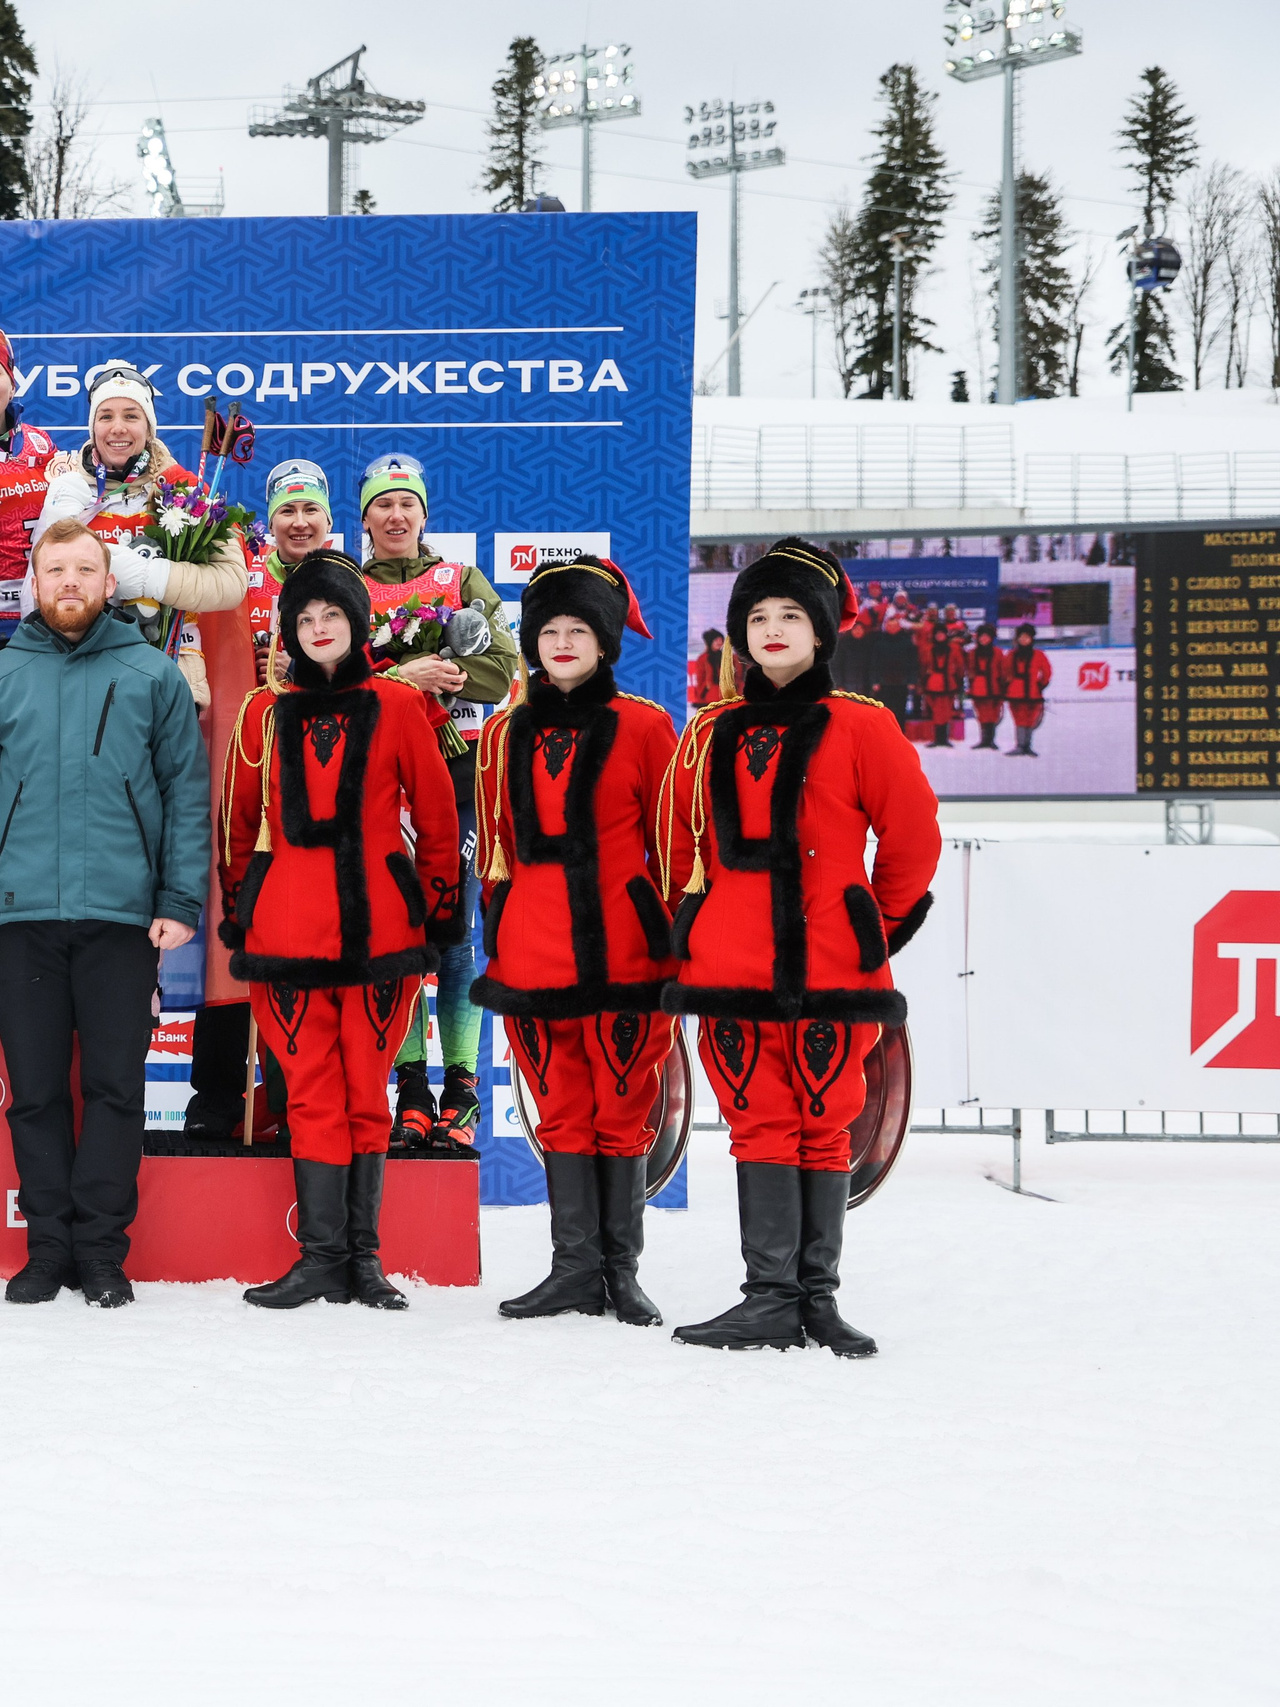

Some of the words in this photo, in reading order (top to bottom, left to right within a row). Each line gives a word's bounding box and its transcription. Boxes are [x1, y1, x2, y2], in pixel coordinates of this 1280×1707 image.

[177, 359, 629, 402] СОДРУЖЕСТВА
[30, 479, 49, 492] Бан
[540, 548, 582, 556] ТЕХНО
[158, 1031, 187, 1042] Банк
[165, 1111, 186, 1121] ПОЛЯ
